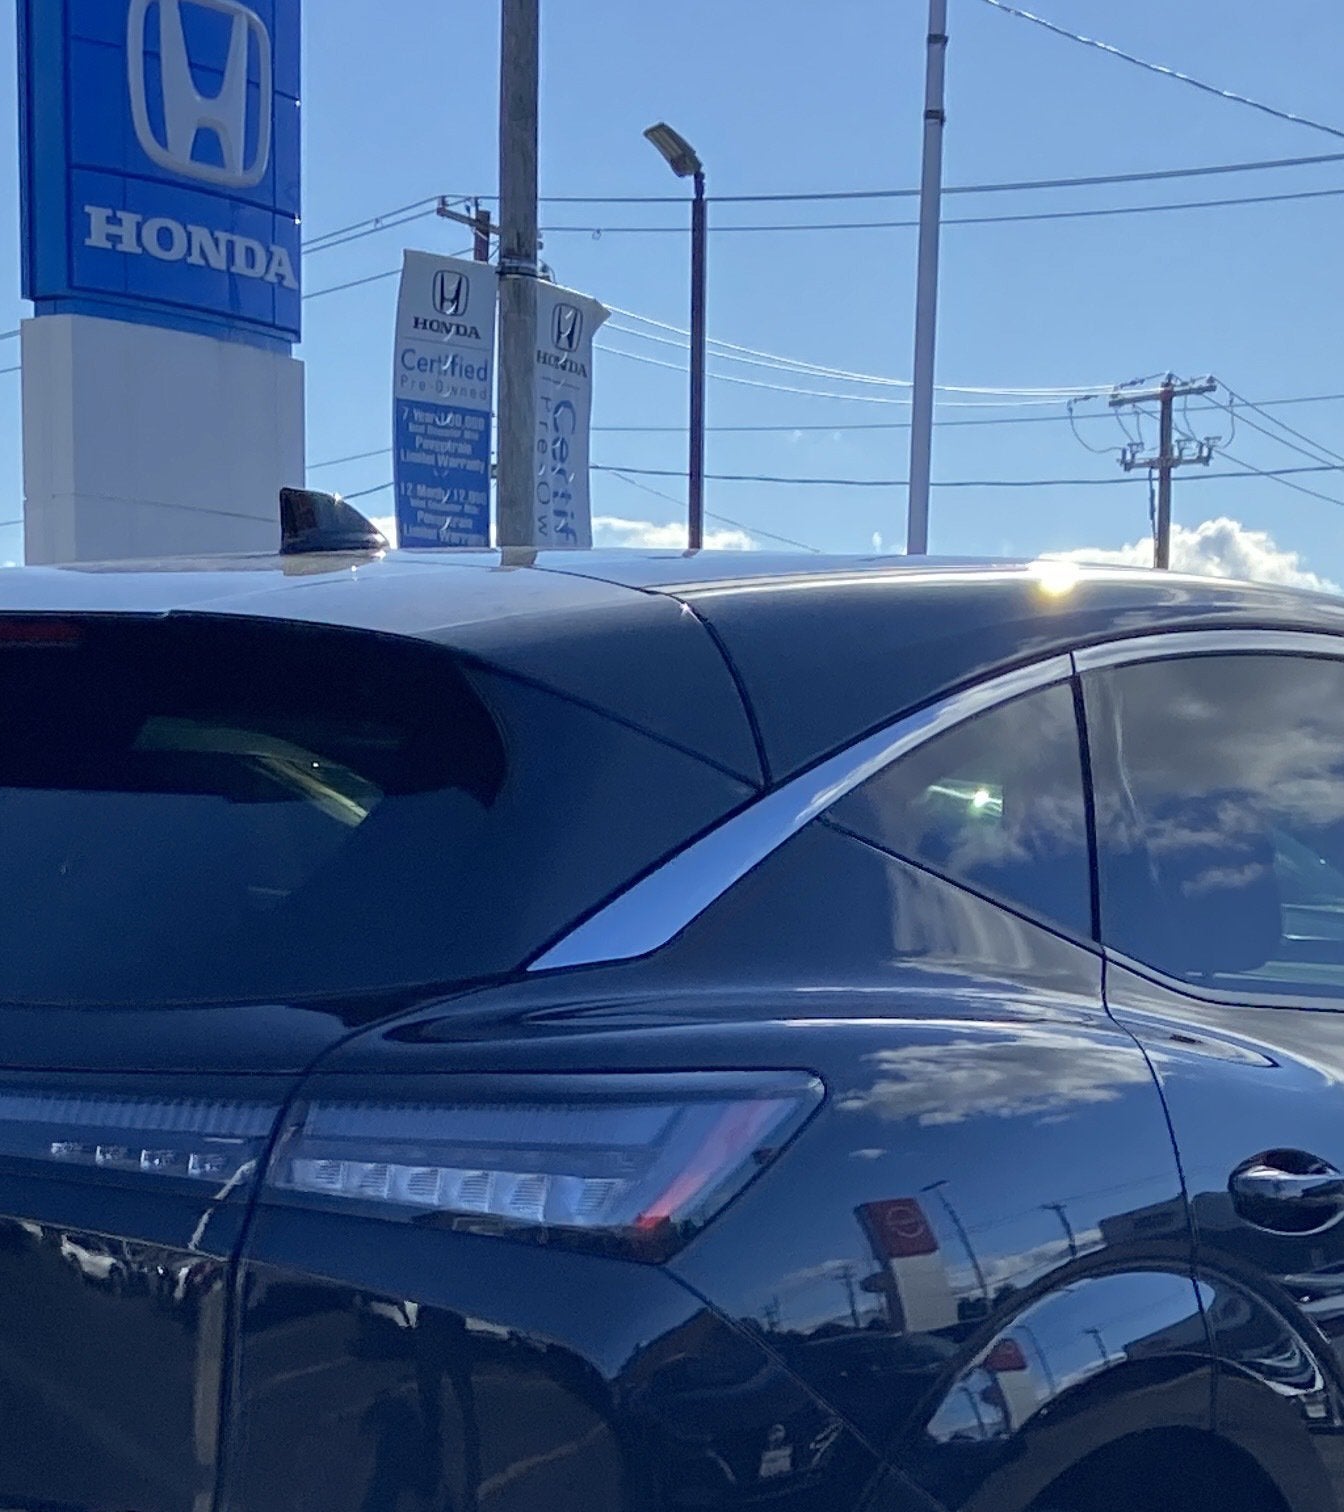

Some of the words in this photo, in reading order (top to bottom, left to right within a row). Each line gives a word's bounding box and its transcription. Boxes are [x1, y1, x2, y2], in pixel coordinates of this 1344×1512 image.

[83, 204, 298, 291] HONDA
[413, 317, 481, 340] HONDA
[401, 348, 488, 382] Certified
[536, 350, 588, 379] HONDA
